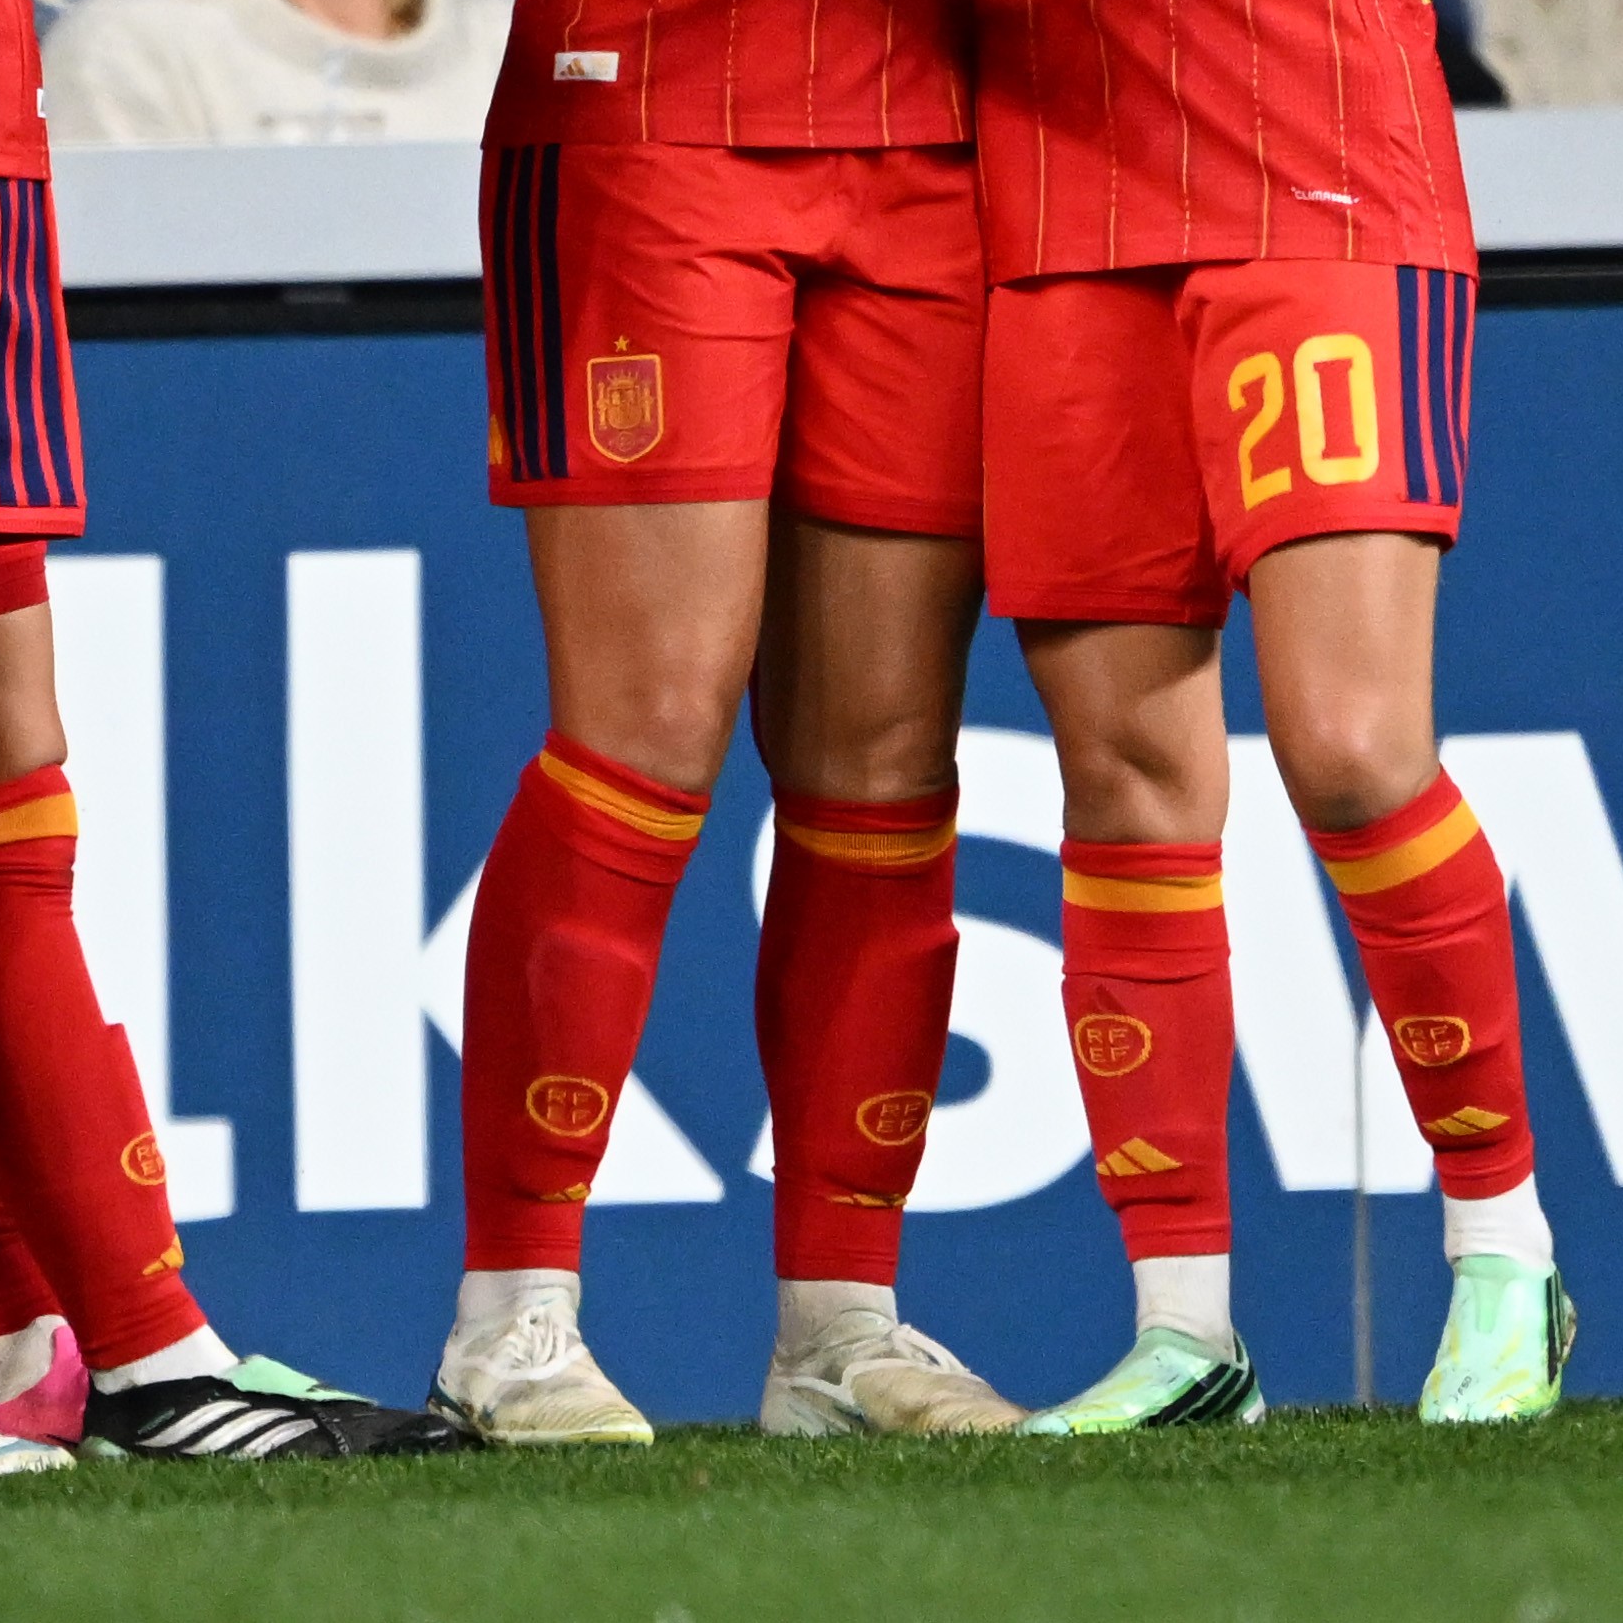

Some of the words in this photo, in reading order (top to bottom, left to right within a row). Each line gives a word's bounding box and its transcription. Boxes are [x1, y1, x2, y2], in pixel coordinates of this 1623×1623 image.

[1227, 333, 1380, 512] 20
[1085, 1027, 1129, 1045] RF
[1088, 1045, 1130, 1063] EF
